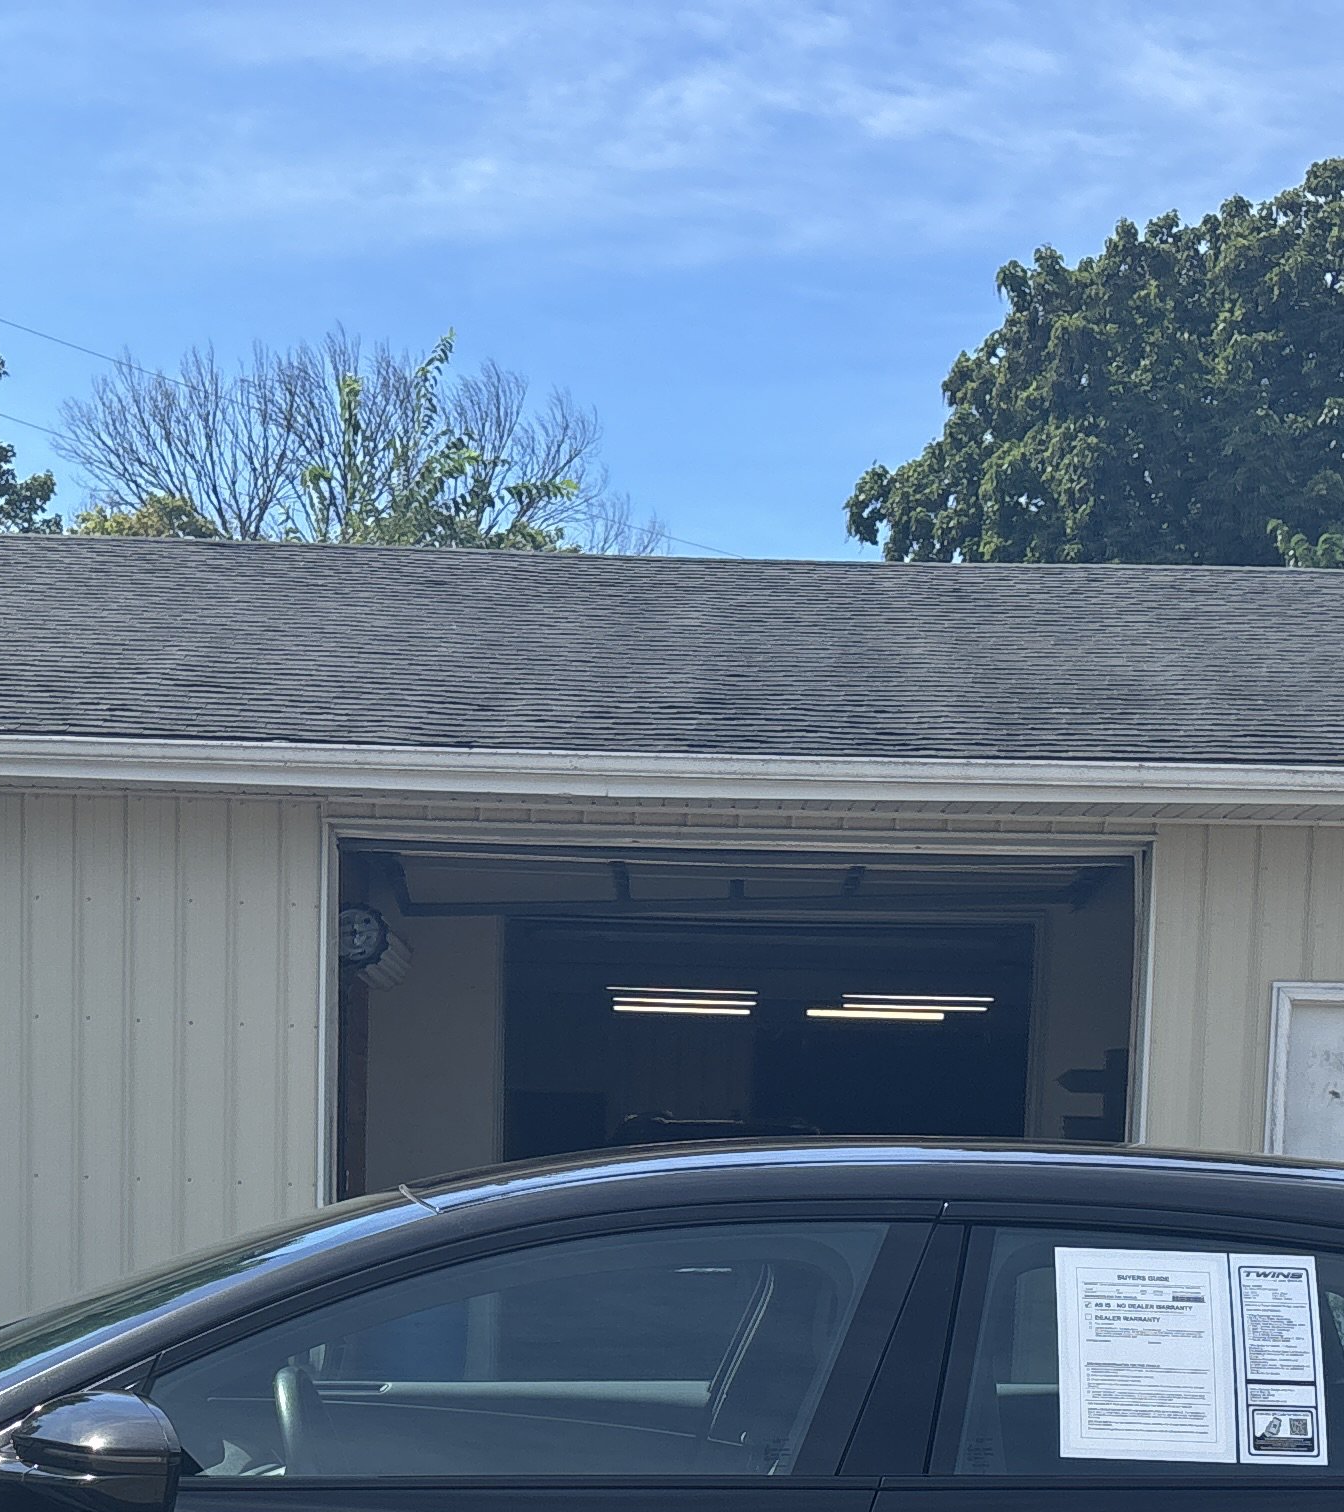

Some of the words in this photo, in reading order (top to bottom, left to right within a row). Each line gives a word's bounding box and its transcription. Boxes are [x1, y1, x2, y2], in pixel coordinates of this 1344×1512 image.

[1117, 1274, 1146, 1282] BUYERS
[1243, 1270, 1304, 1280] TWINS
[1123, 1315, 1160, 1323] WARRANTY
